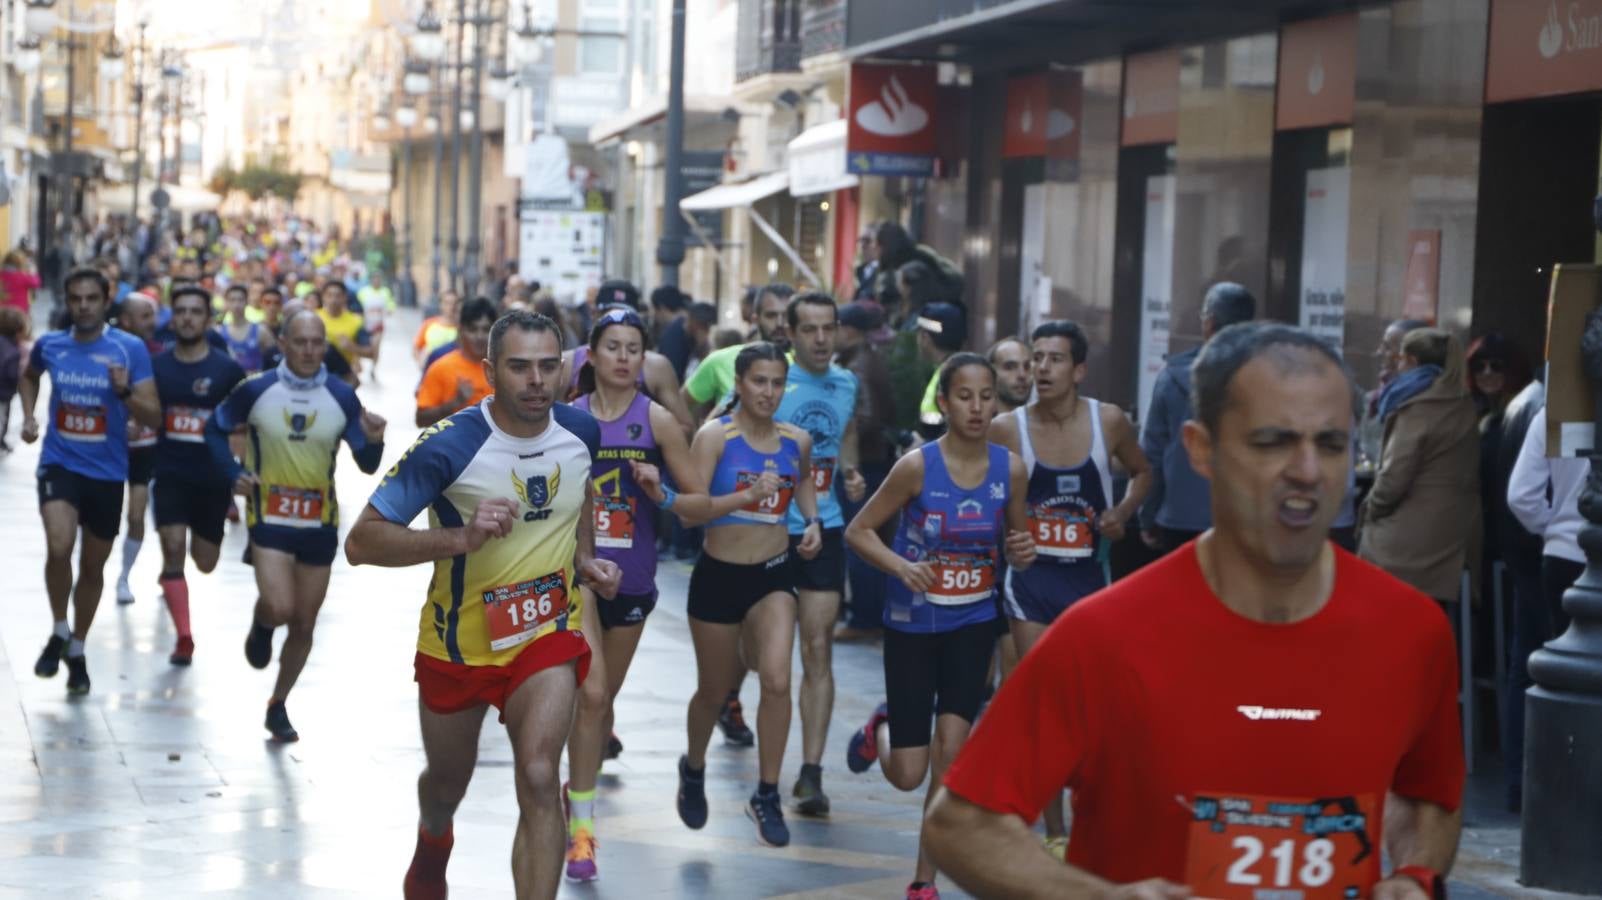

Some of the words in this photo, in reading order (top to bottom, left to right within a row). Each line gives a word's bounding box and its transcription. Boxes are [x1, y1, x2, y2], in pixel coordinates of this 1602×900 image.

[1566, 2, 1602, 52] San
[64, 414, 96, 432] 859
[620, 449, 646, 460] LORCA
[810, 470, 825, 487] 8
[278, 496, 311, 516] 211
[1038, 522, 1078, 543] 516
[942, 569, 982, 589] 505
[484, 592, 494, 602] VI
[507, 593, 552, 626] 186
[1226, 835, 1335, 887] 218
